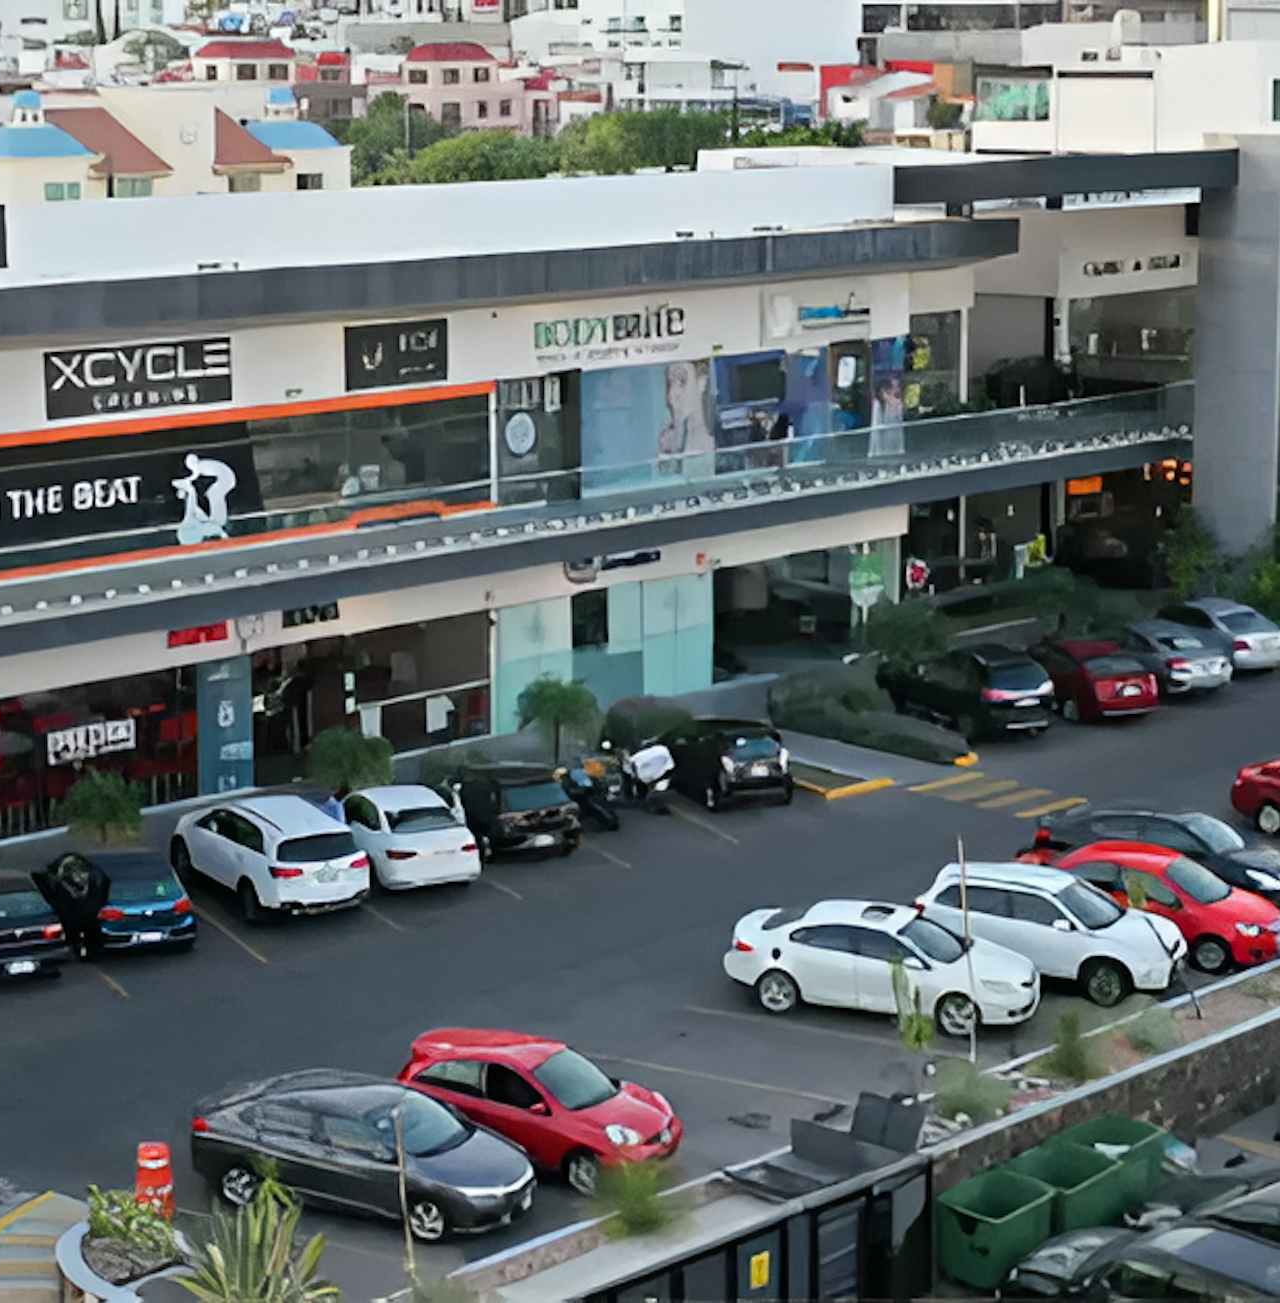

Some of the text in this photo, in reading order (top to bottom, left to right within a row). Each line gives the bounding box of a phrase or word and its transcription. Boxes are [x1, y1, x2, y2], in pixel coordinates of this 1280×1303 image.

[49, 342, 230, 391] XCYCLE
[6, 485, 63, 519] THE
[72, 475, 142, 511] BEAT
